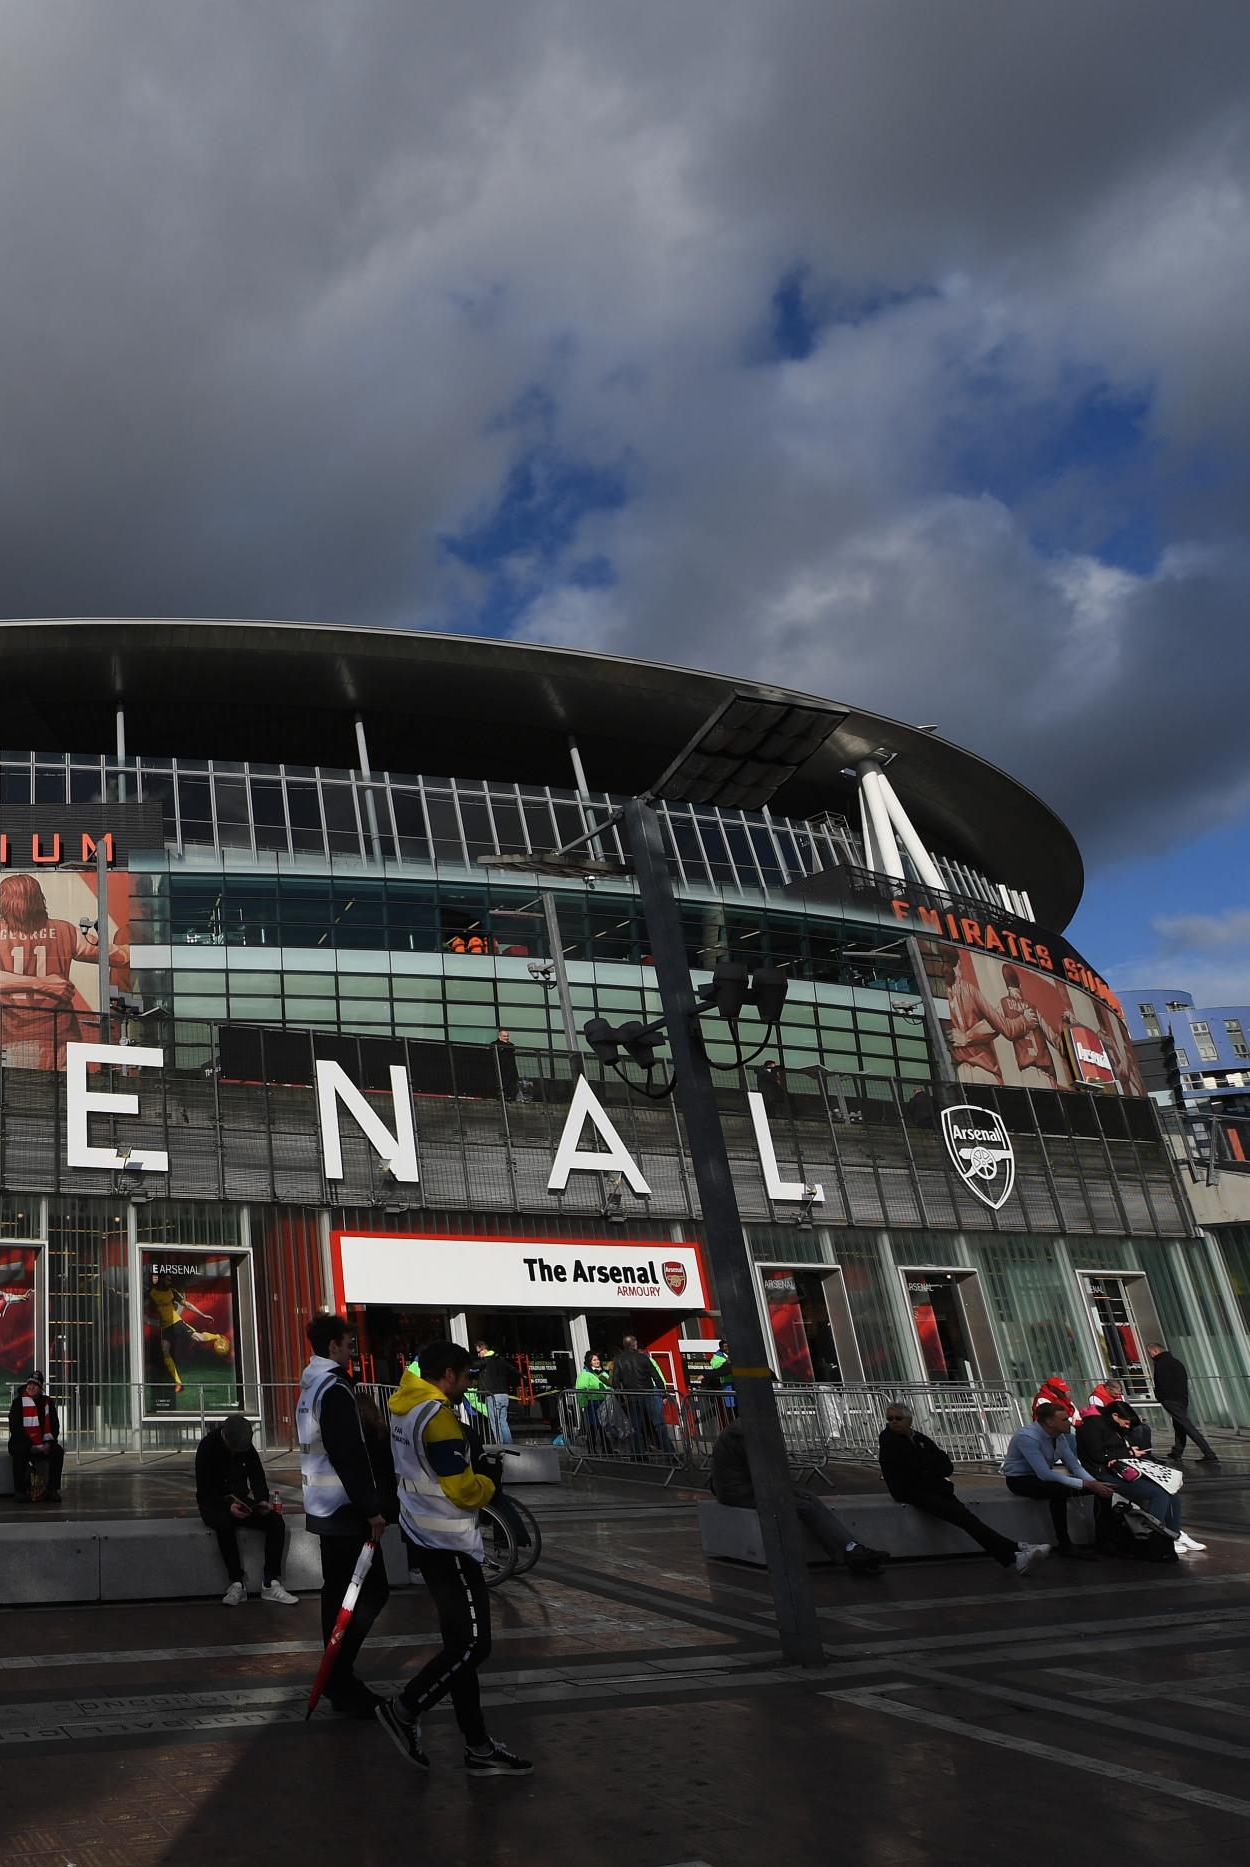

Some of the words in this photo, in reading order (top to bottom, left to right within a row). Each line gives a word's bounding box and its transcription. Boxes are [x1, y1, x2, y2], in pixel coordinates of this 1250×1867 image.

[0, 928, 57, 940] GEORGE
[892, 900, 1052, 969] EMIRATES
[11, 945, 47, 979] 11
[953, 1124, 1002, 1142] Arsenal
[159, 1264, 202, 1275] ARSENAL
[523, 1258, 567, 1283] The
[572, 1259, 659, 1285] Arsenal
[616, 1286, 661, 1297] ARMOURY
[764, 1279, 796, 1290] ARSENAL
